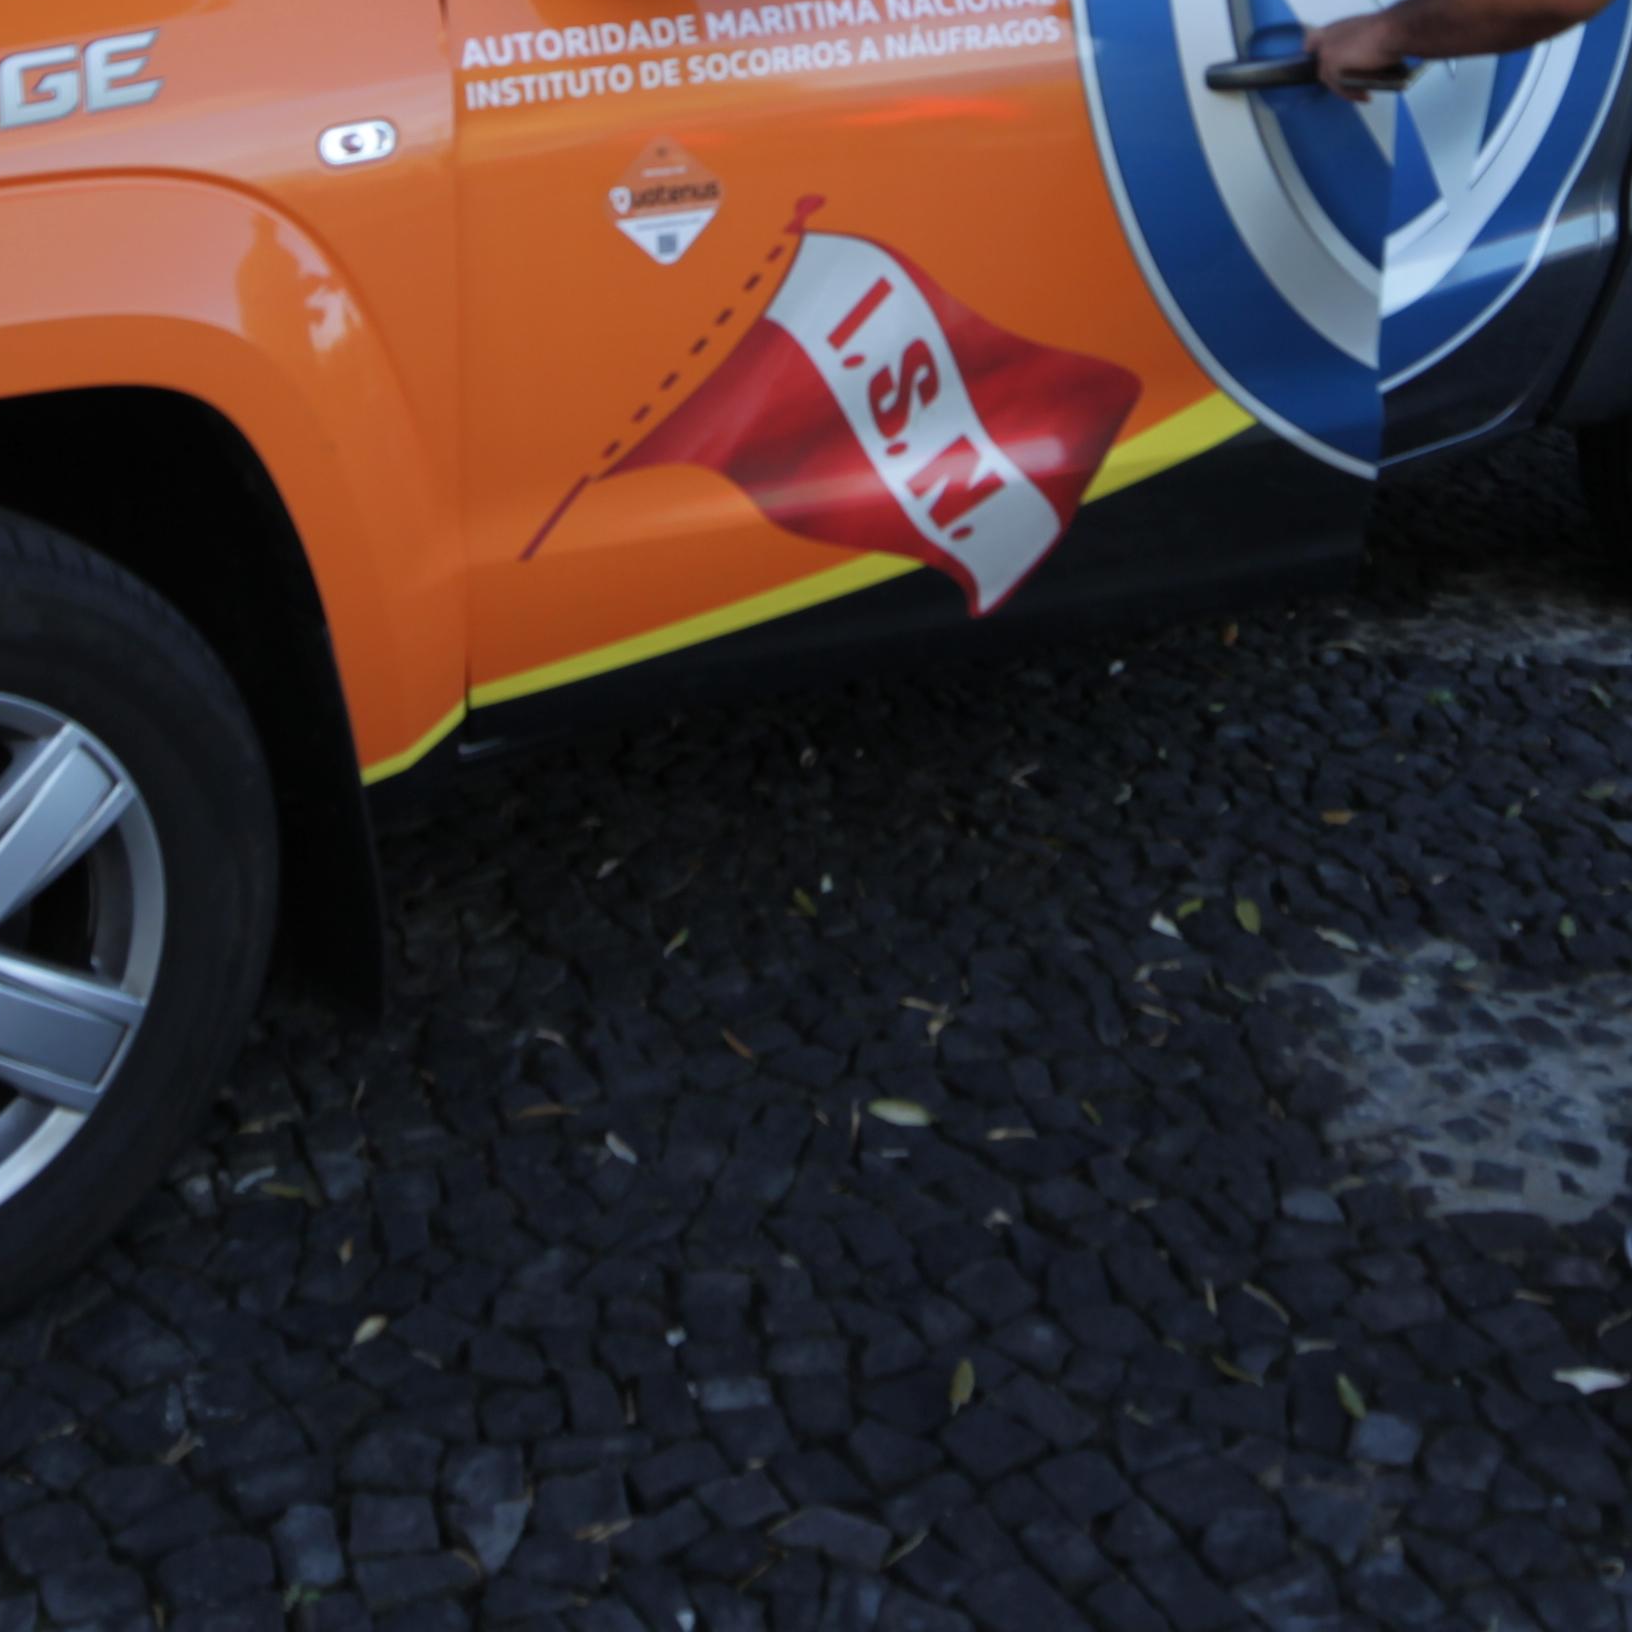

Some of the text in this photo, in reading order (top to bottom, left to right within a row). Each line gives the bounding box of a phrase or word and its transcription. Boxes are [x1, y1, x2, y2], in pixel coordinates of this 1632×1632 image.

[462, 14, 699, 70] AUTORIDADE
[464, 14, 1062, 111] INSTITUTO DE SOCORROS A NÁUFRAGOS
